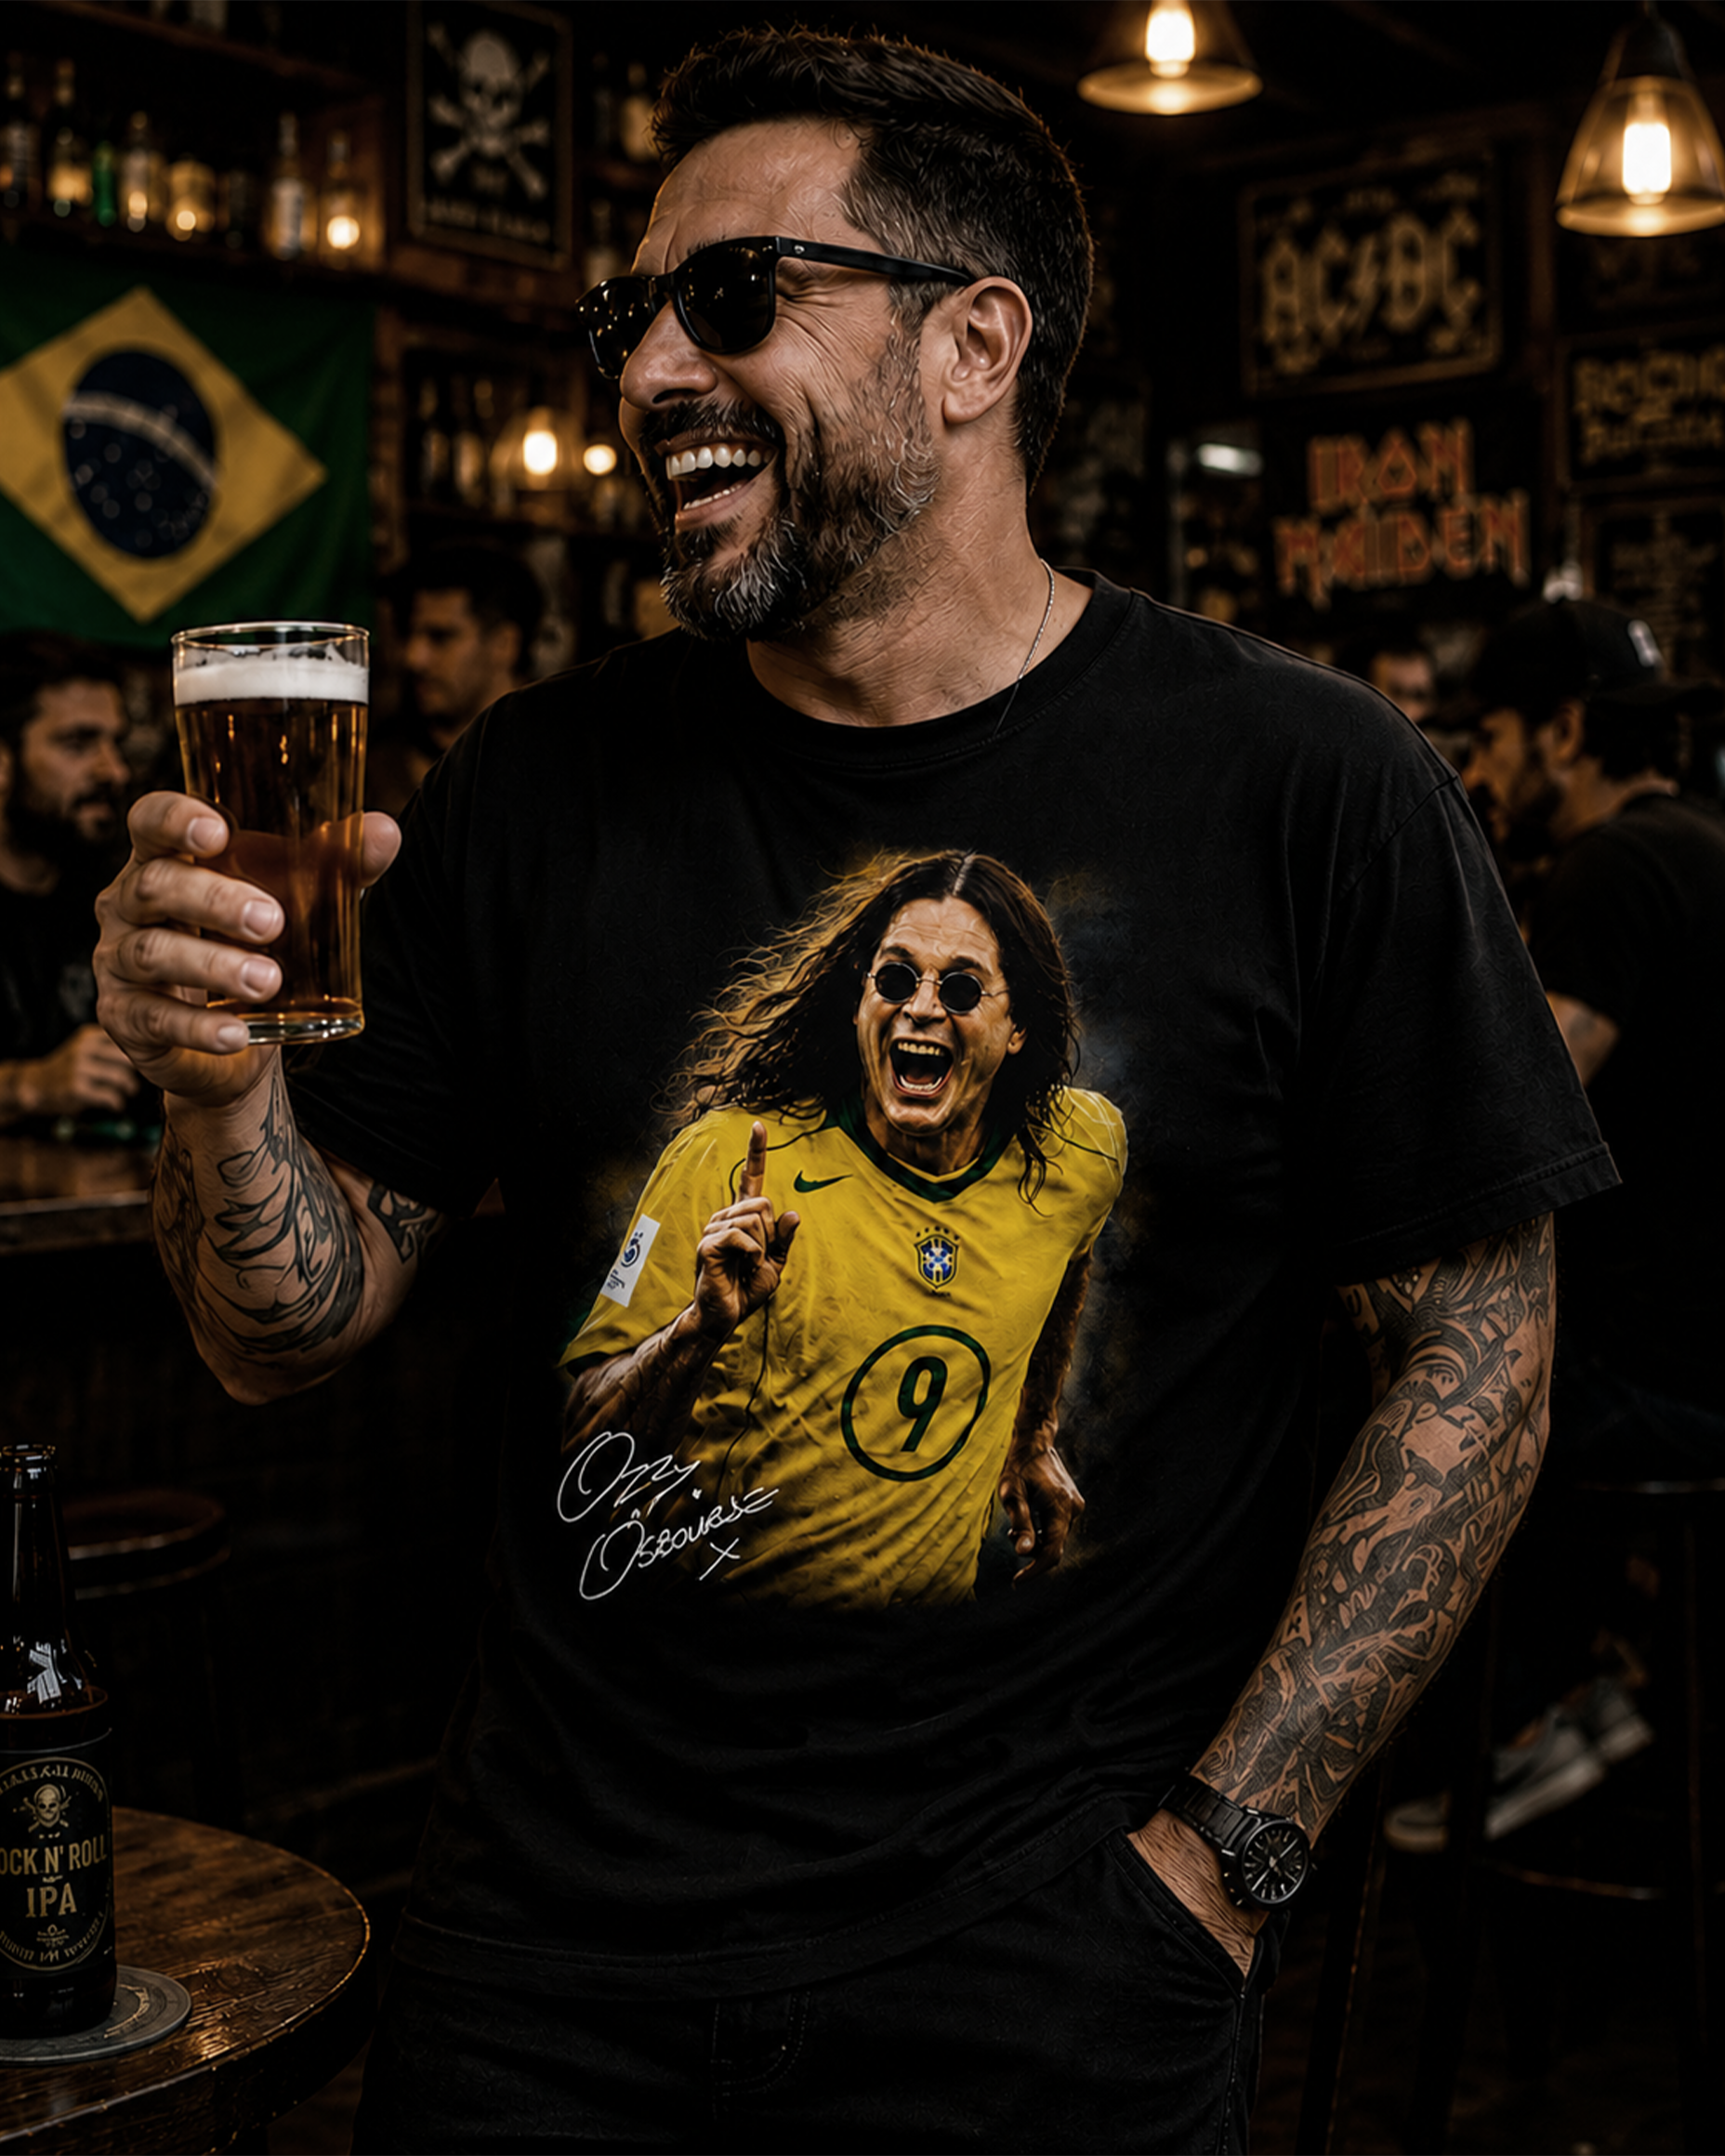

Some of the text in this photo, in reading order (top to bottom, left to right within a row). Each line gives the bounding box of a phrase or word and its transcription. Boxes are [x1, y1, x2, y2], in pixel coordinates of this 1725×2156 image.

[1271, 487, 1533, 613] MAIDEN
[898, 1356, 948, 1453] 9
[45, 1844, 64, 1874] N'
[69, 1834, 108, 1872] ROLL
[25, 1882, 78, 1919] IPA
